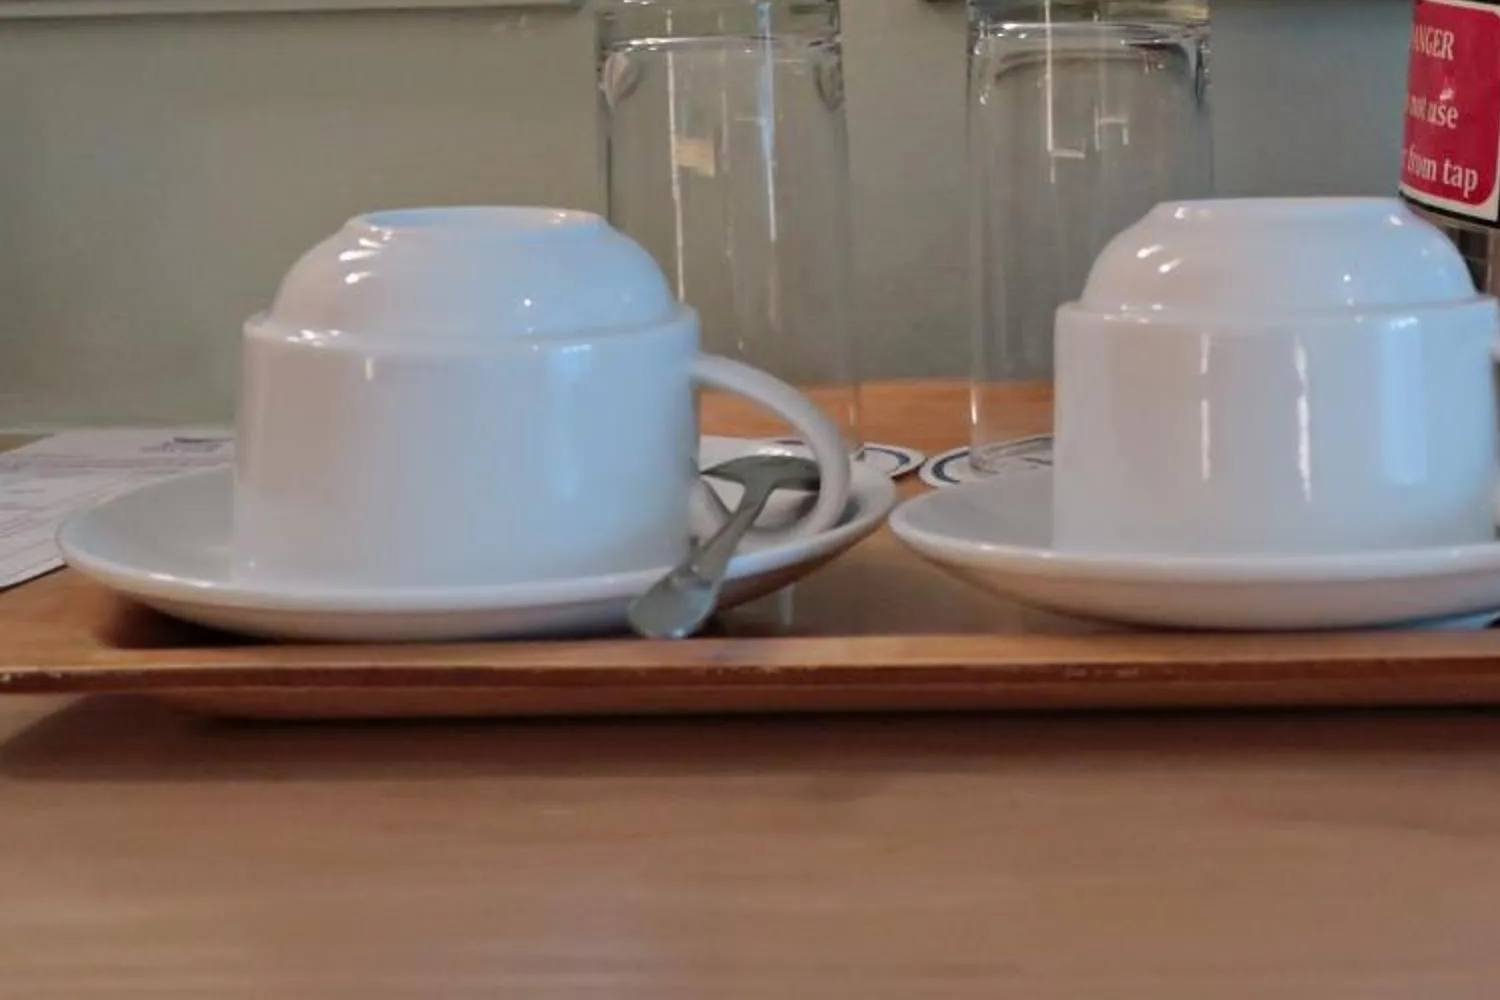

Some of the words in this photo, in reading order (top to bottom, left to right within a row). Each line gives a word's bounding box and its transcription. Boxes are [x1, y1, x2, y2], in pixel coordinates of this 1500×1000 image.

[1427, 101, 1459, 129] use
[1407, 143, 1437, 182] from
[1443, 157, 1478, 199] tap
